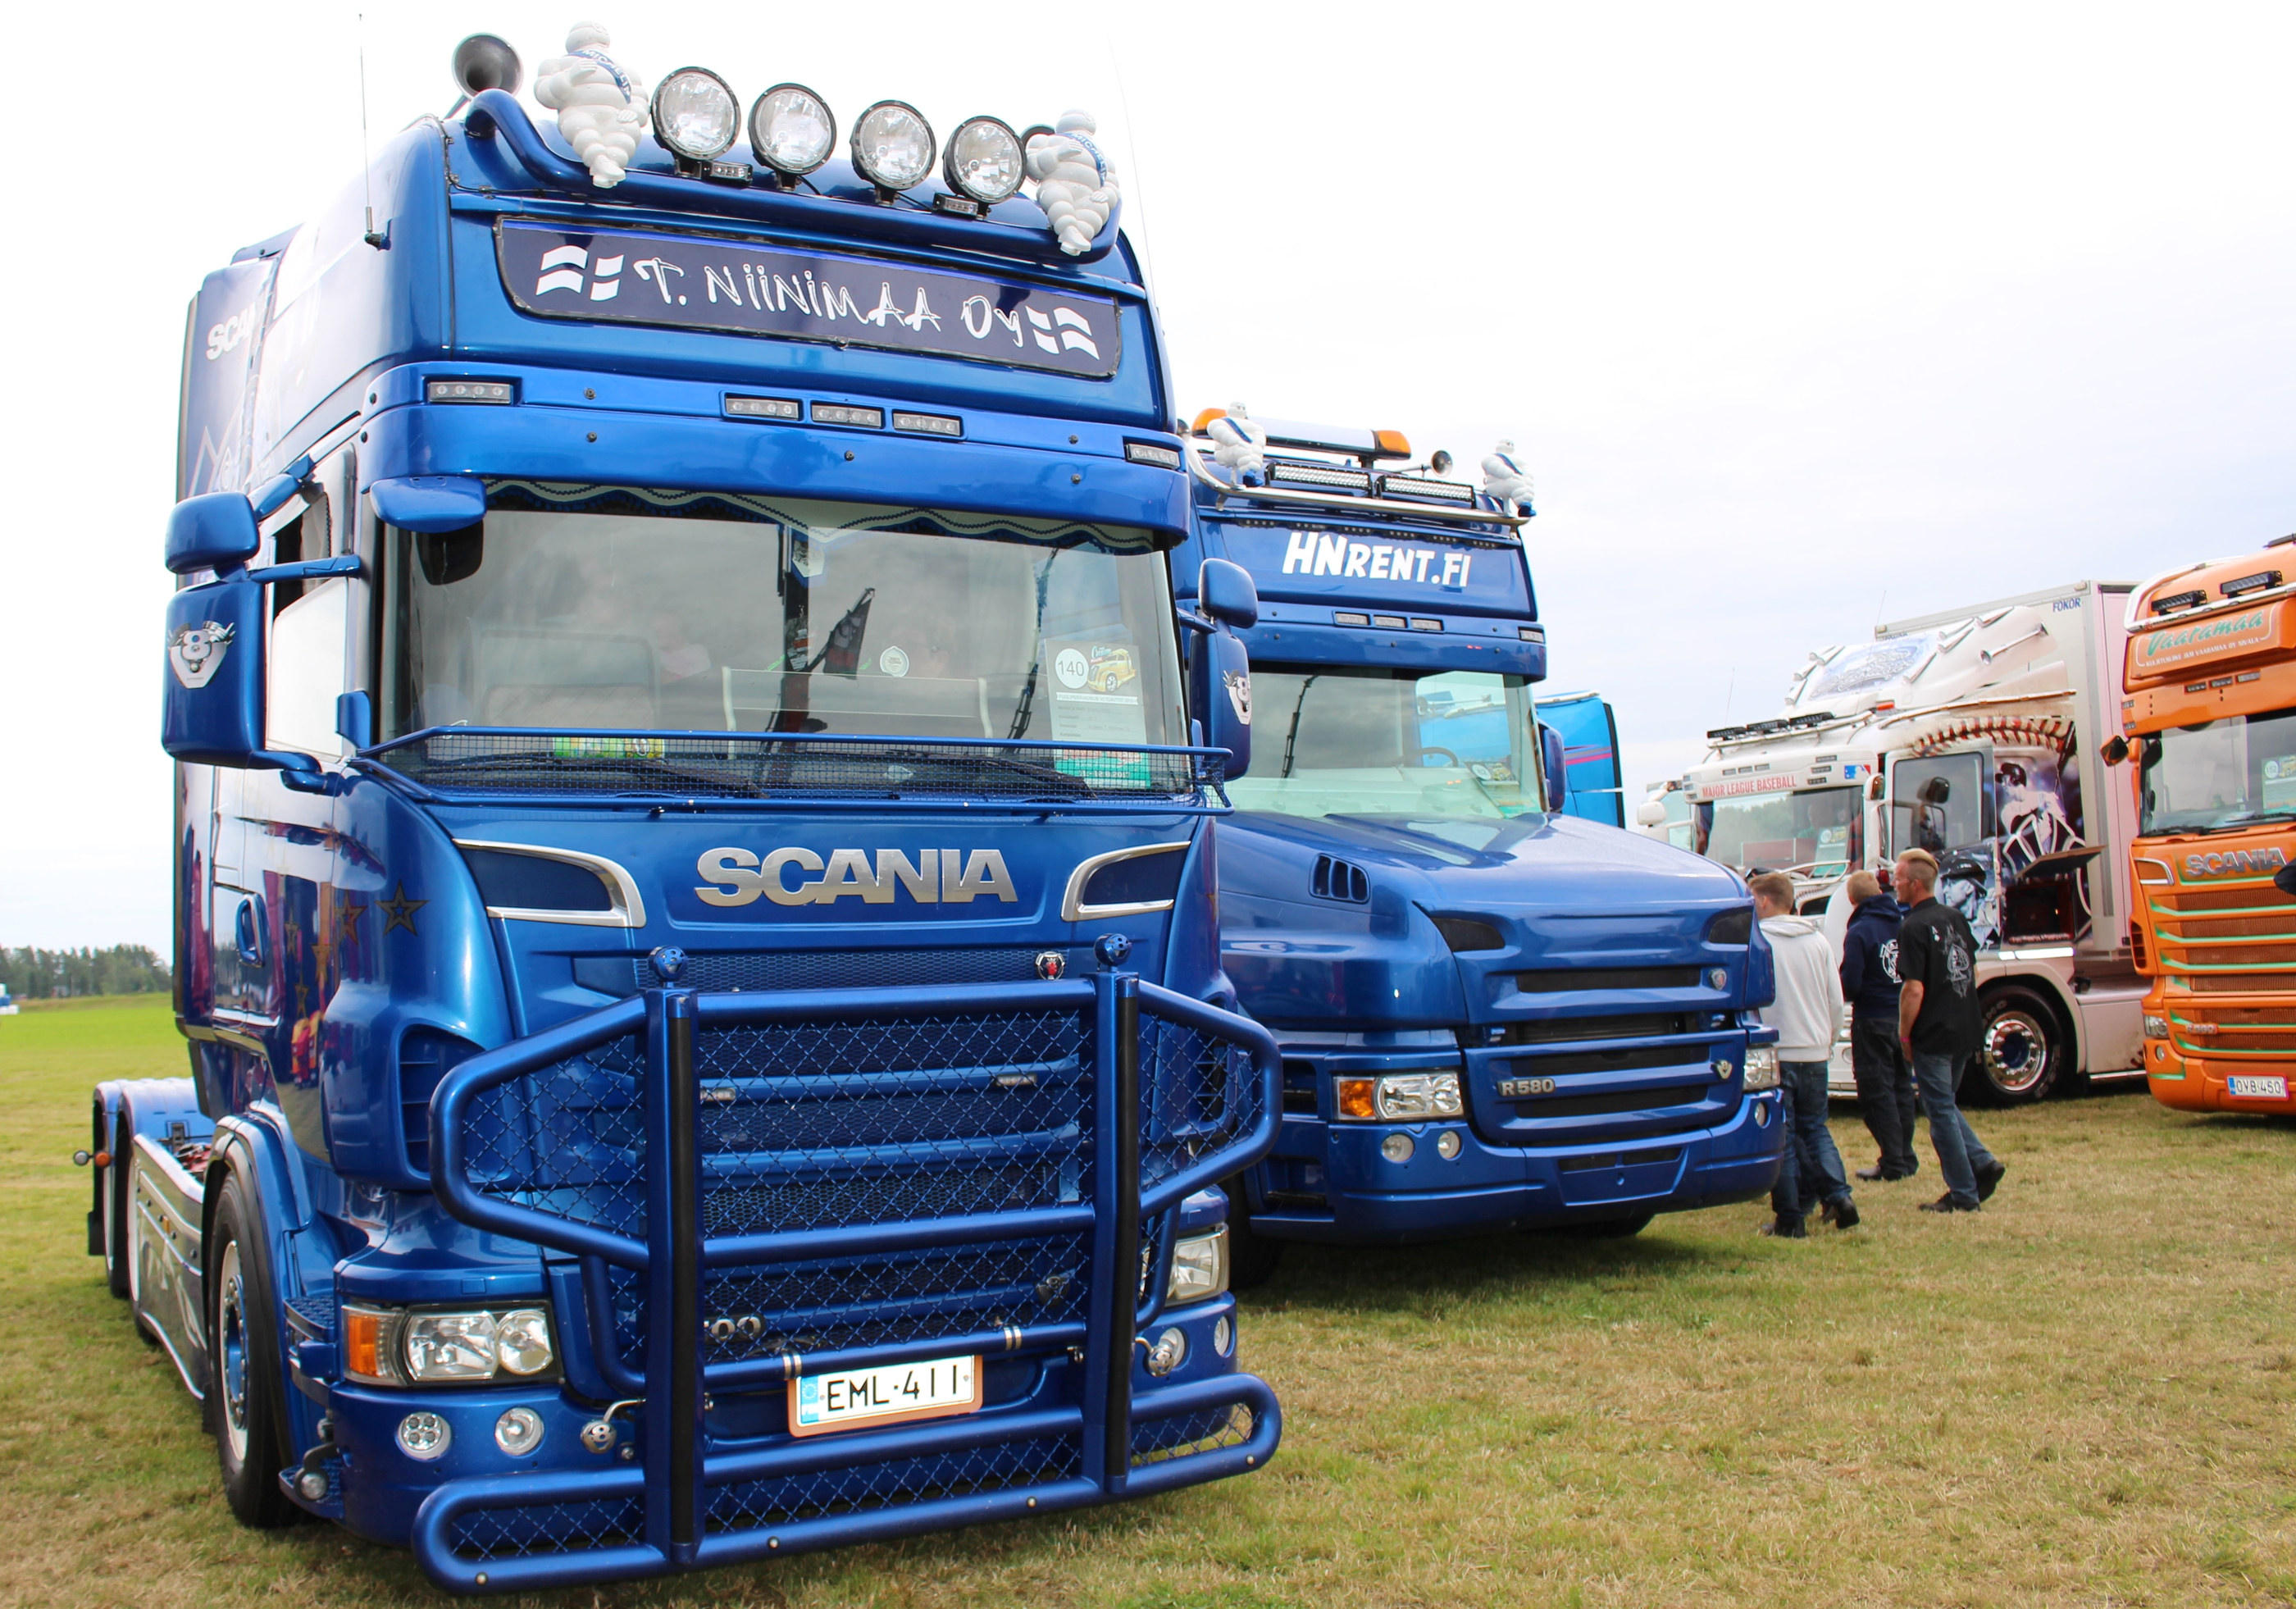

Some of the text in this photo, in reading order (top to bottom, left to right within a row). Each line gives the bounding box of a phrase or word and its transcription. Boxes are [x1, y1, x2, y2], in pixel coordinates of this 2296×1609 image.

[633, 257, 687, 306] T.
[1282, 531, 1472, 587] HNRENT.FI
[2146, 610, 2264, 657] Vaaramaa
[1058, 660, 1084, 677] 140
[1702, 775, 1797, 799] MAJOR LEAGUE BASEBALL
[695, 847, 1018, 907] SCANIA
[2185, 847, 2287, 877] SCANIA
[1501, 1078, 1555, 1096] R 580
[827, 1364, 958, 1412] EML-411
